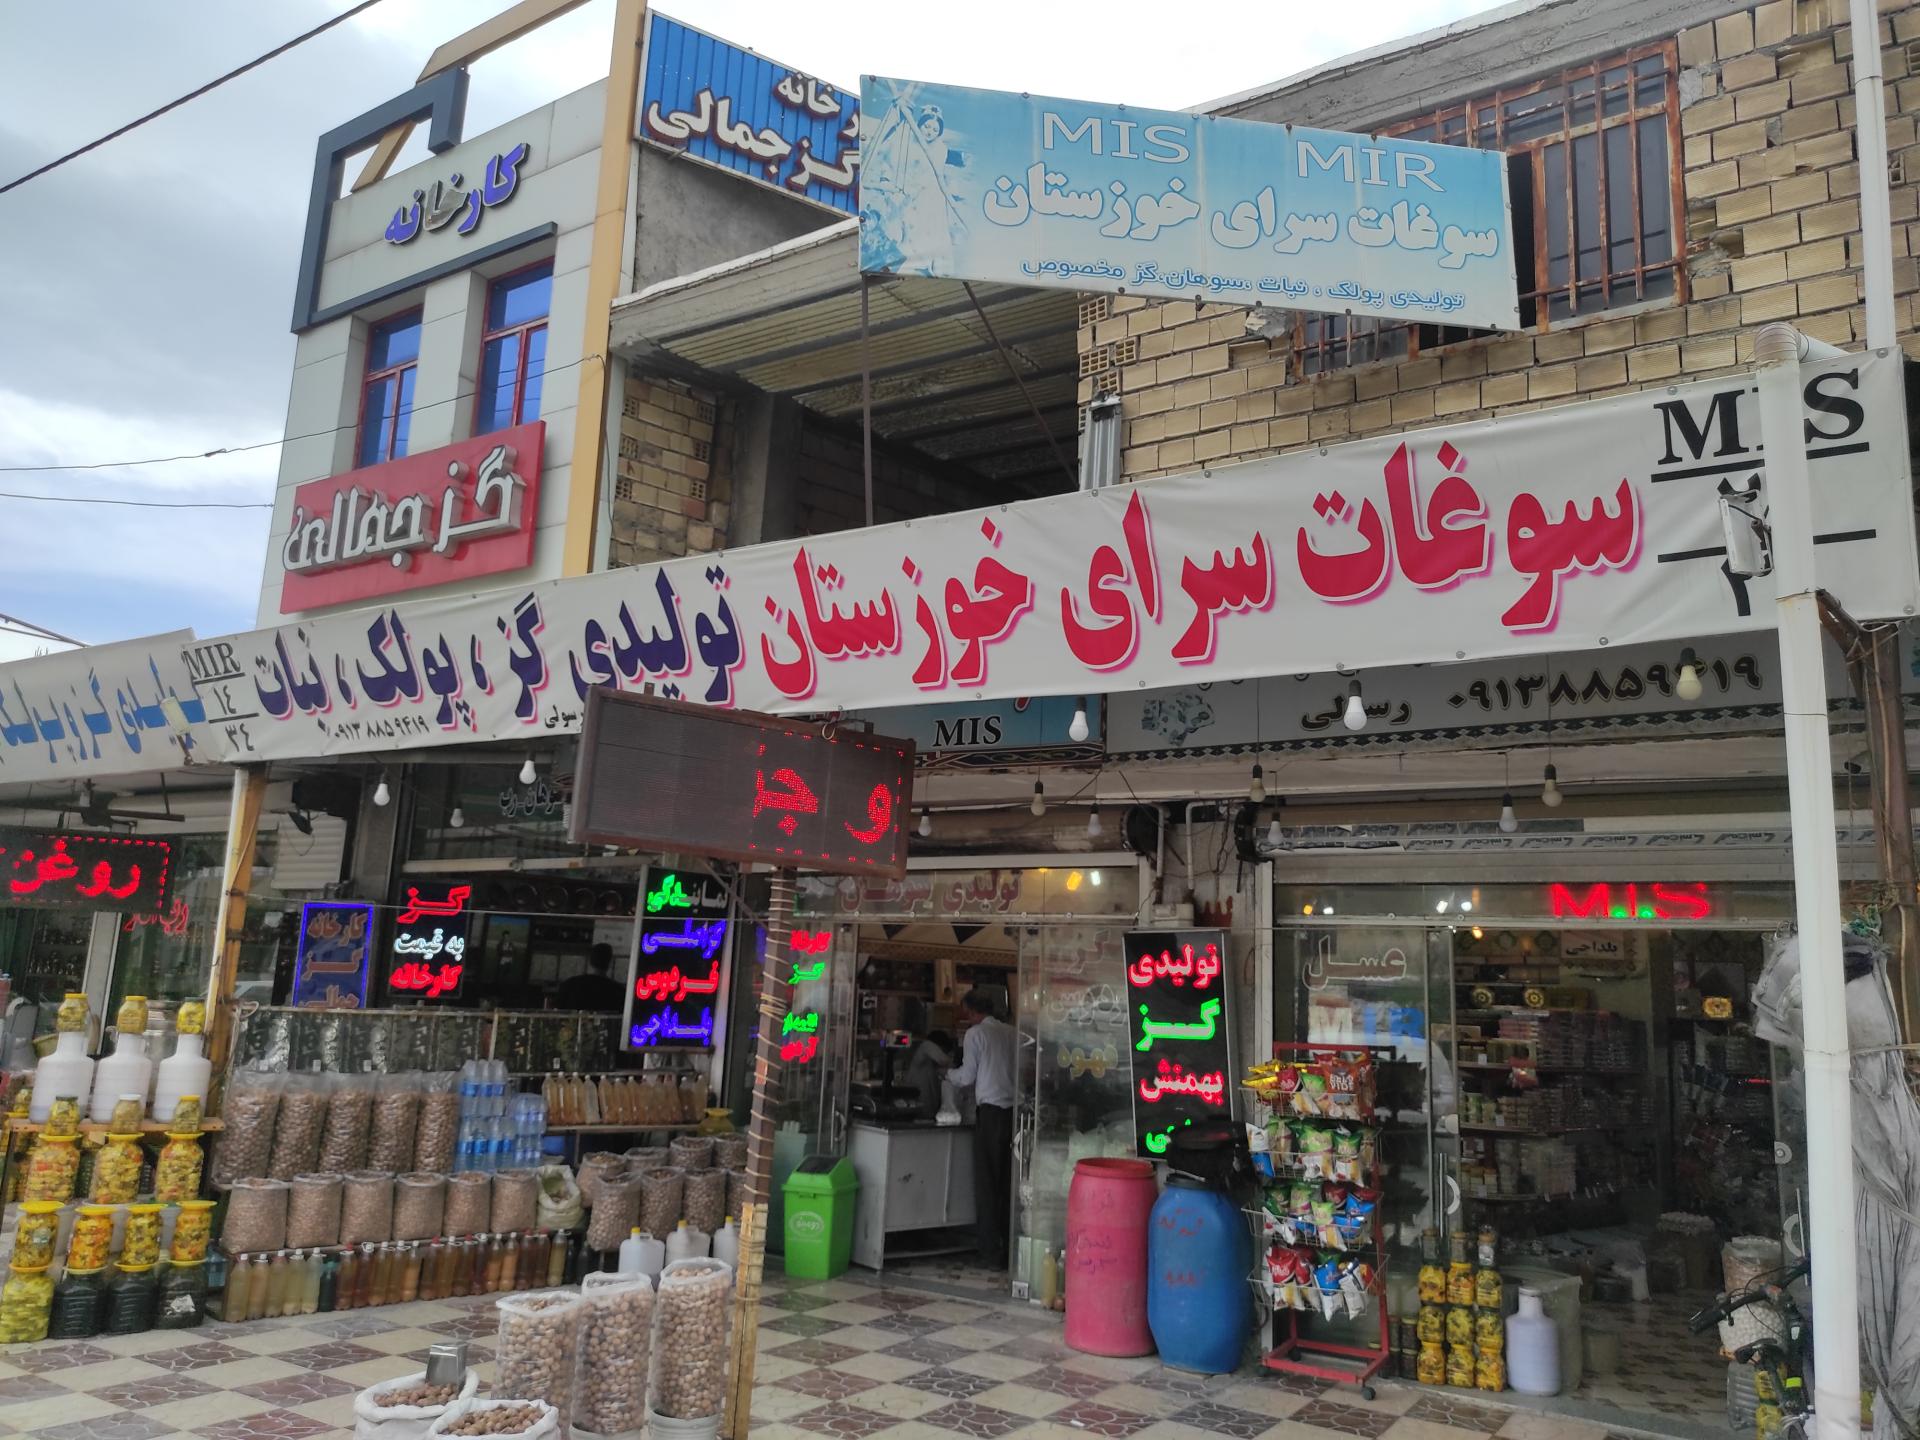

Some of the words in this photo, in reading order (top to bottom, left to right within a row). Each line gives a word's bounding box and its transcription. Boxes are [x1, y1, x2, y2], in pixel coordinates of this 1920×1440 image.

[646, 88, 795, 172] جمالی
[1043, 112, 1190, 164] MIS
[1296, 139, 1447, 192] MIR
[383, 142, 531, 247] کارخانه
[983, 161, 1200, 241] خوزستان
[1211, 186, 1338, 255] سرای
[1022, 258, 1126, 280] مخصوص
[1348, 199, 1498, 269] سوغات
[1389, 286, 1466, 312] تولیدی
[1653, 368, 1865, 466] MS
[281, 480, 435, 572] جمالی
[432, 443, 526, 554] گز
[1296, 440, 1642, 635] سوغات
[760, 515, 1036, 700] خوزستان
[1060, 488, 1275, 670] سرای
[183, 642, 241, 680] MIR
[568, 565, 747, 709] تولیدی
[252, 627, 331, 734] نبات
[1300, 692, 1412, 732] رسلی
[931, 715, 1002, 748] MIS
[9, 839, 142, 899] روغن
[397, 885, 472, 924] گز
[301, 947, 364, 982] گز
[1128, 943, 1222, 990] تولیدی
[1136, 997, 1221, 1051] گز
